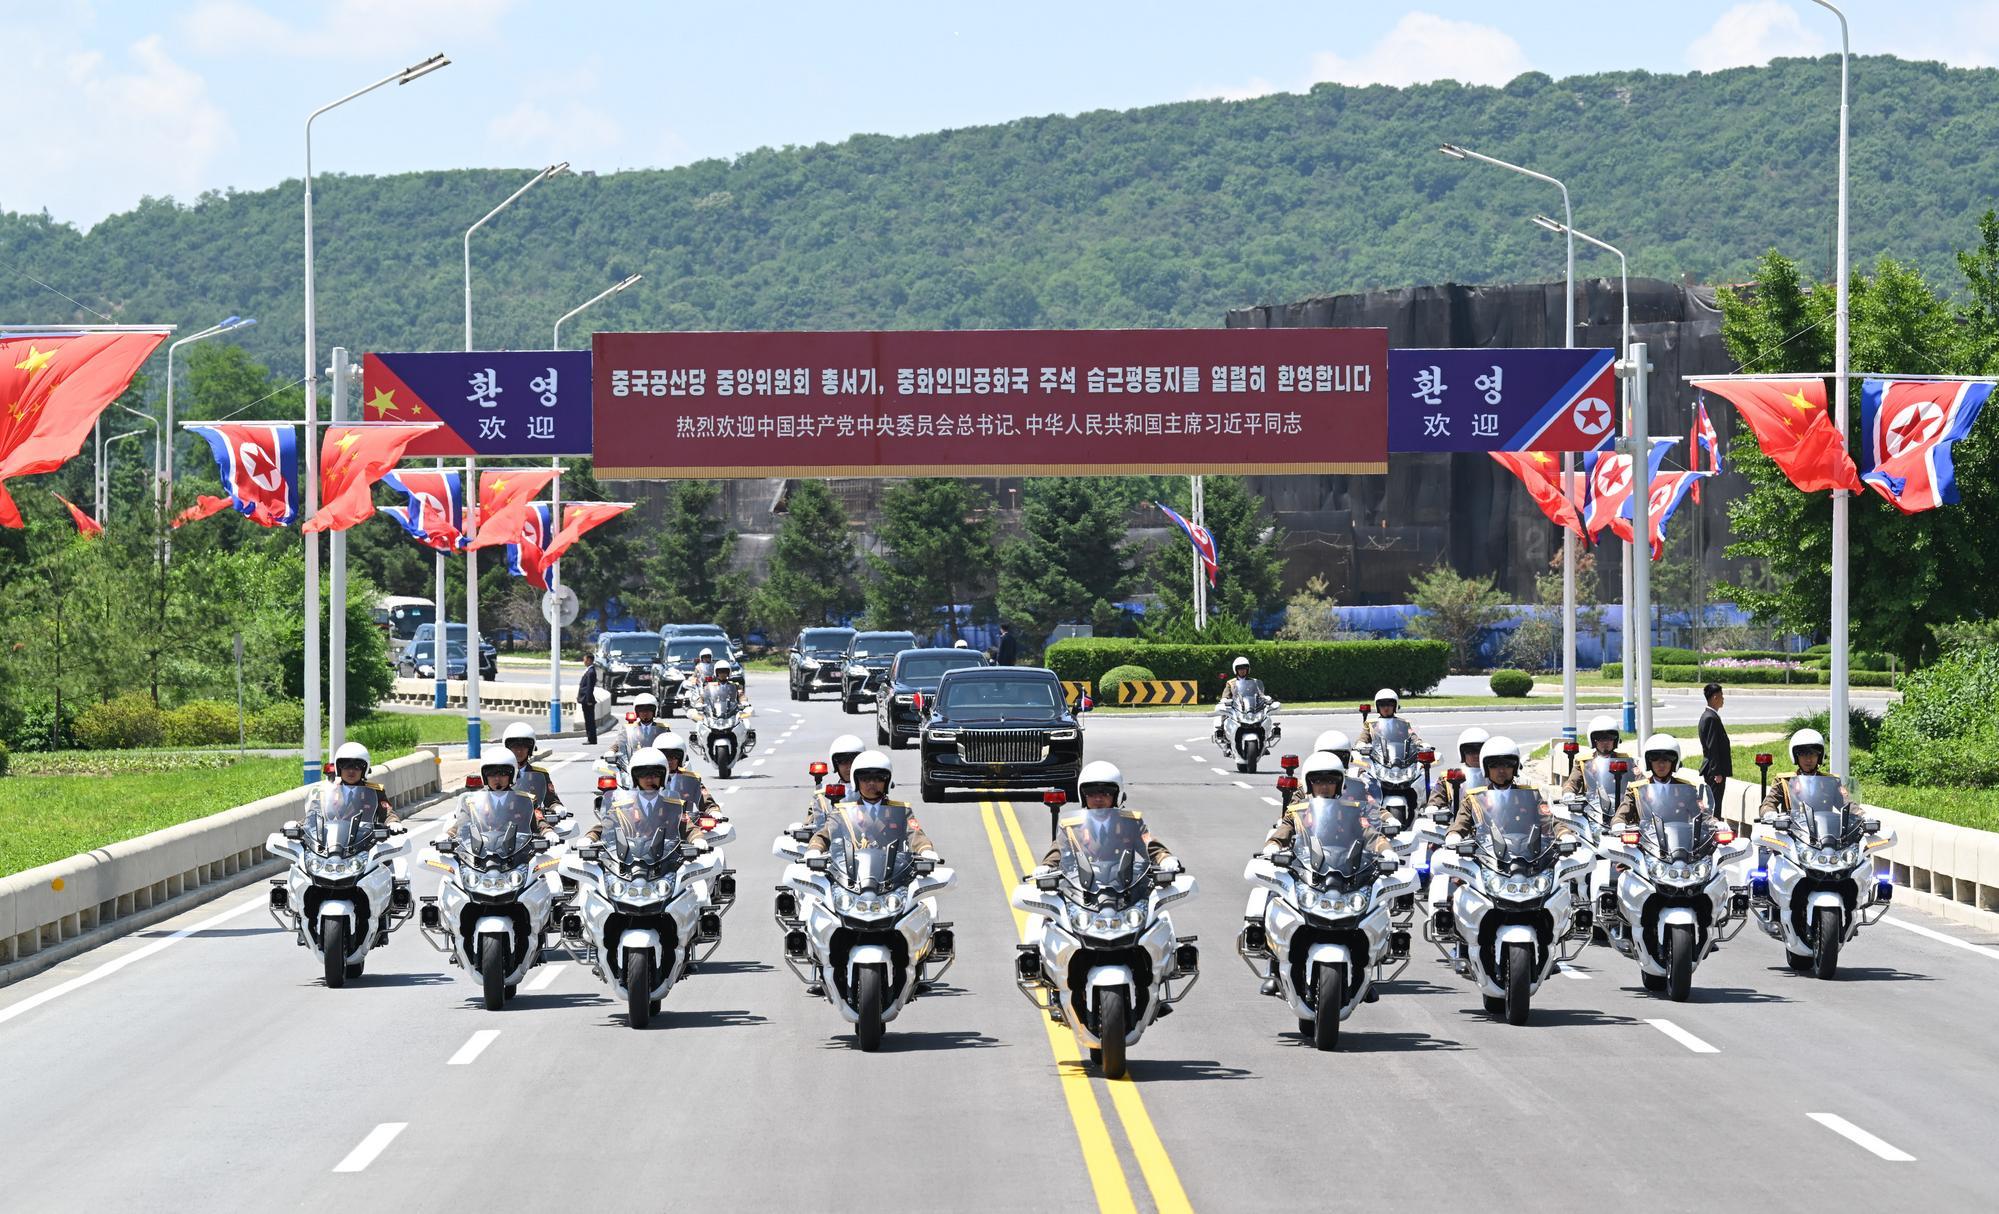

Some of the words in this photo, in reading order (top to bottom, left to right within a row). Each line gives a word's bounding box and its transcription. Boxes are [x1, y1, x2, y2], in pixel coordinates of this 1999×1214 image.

[466, 367, 558, 408] 환영
[611, 368, 706, 397] 중국공산당
[716, 367, 810, 396] 중앙위원회
[821, 367, 885, 395] 총서기,
[897, 367, 1029, 395] 중화인민공화국
[1039, 366, 1076, 394] 주석
[1087, 365, 1200, 394] 습근평동지를
[1211, 365, 1265, 393] 열렬히
[1277, 364, 1371, 392] 환영합니다
[1411, 365, 1503, 405] 환영
[478, 415, 555, 440] 欢迎
[676, 411, 1302, 438] 热烈欢迎中国共产党中央委员会总书记、中华人民共和国主席习近平同志
[1423, 413, 1499, 437] 欢迎
